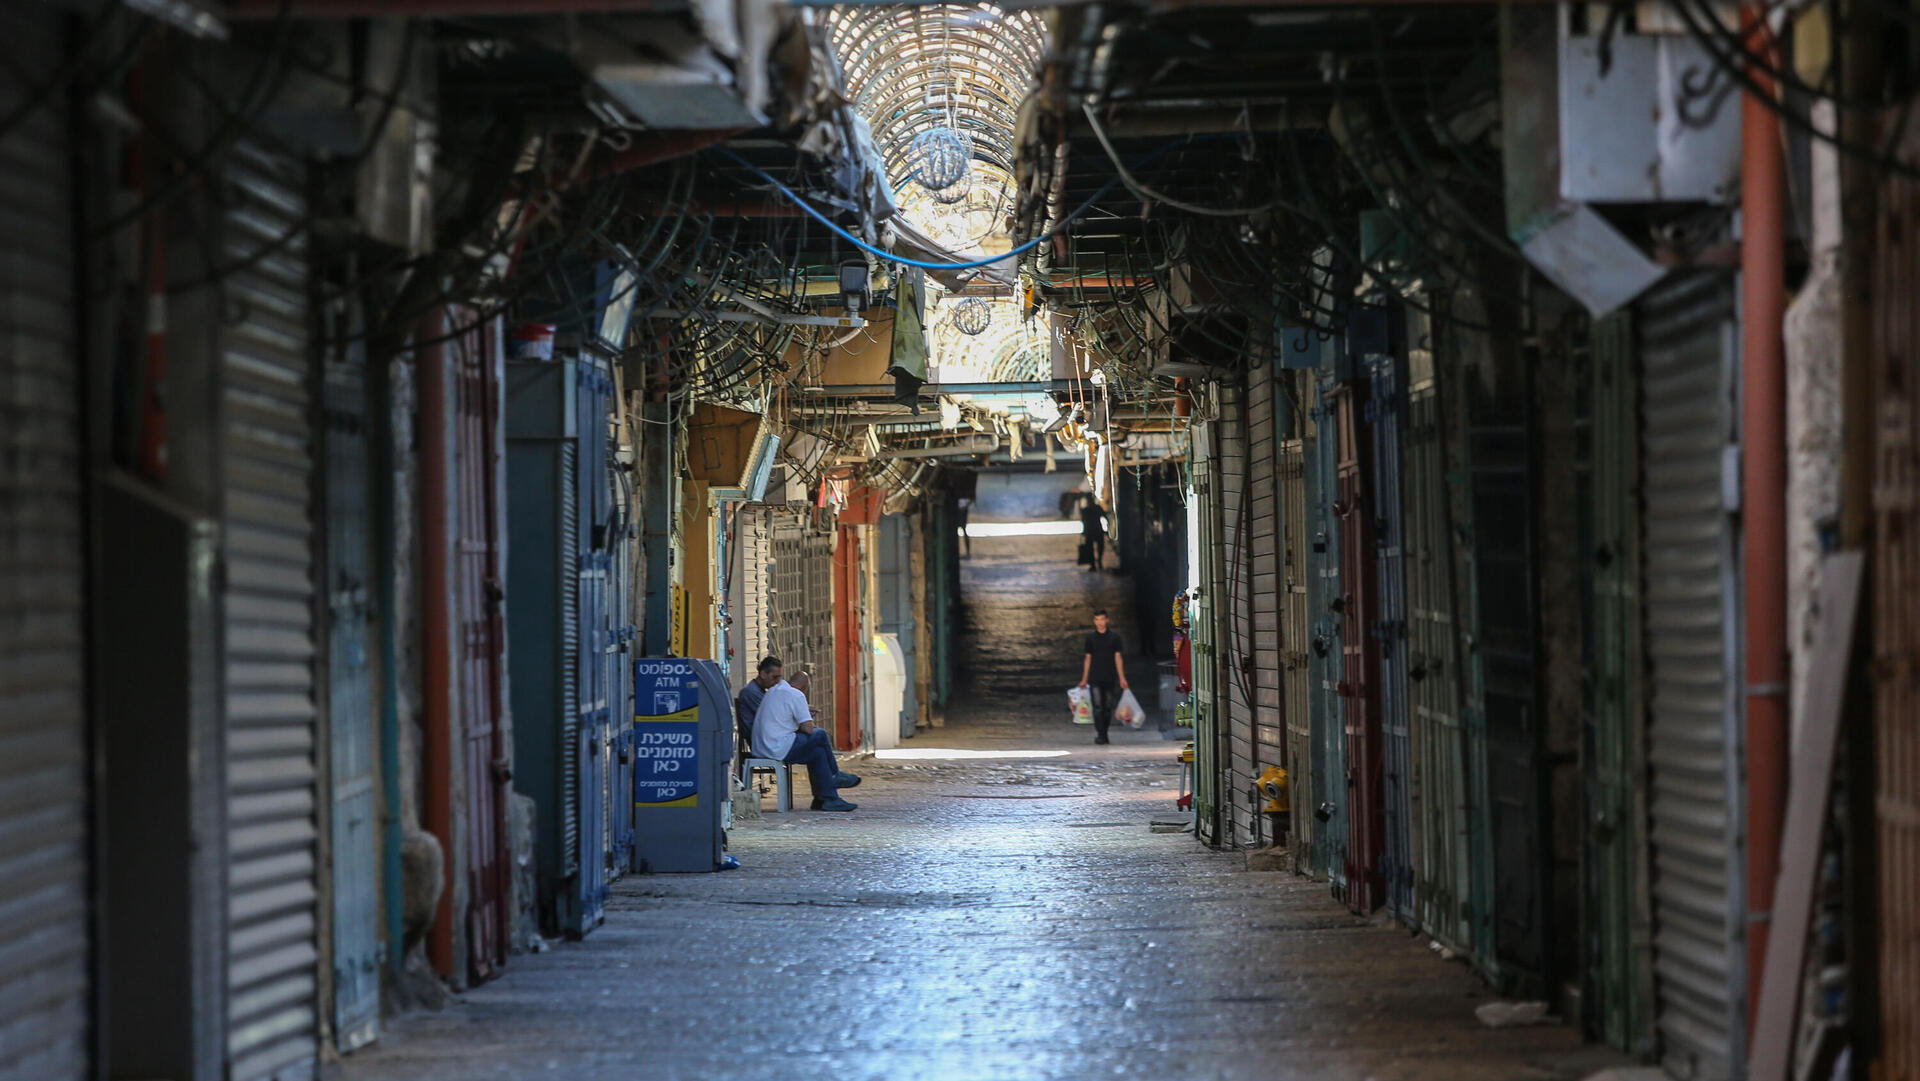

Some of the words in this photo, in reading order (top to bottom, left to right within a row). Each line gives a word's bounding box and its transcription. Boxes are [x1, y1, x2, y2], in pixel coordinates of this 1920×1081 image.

[655, 677, 680, 687] ATM
[640, 733, 693, 744] משיכת
[638, 747, 695, 758] מזומנים
[653, 760, 680, 774] כאן
[657, 788, 677, 798] כאן
